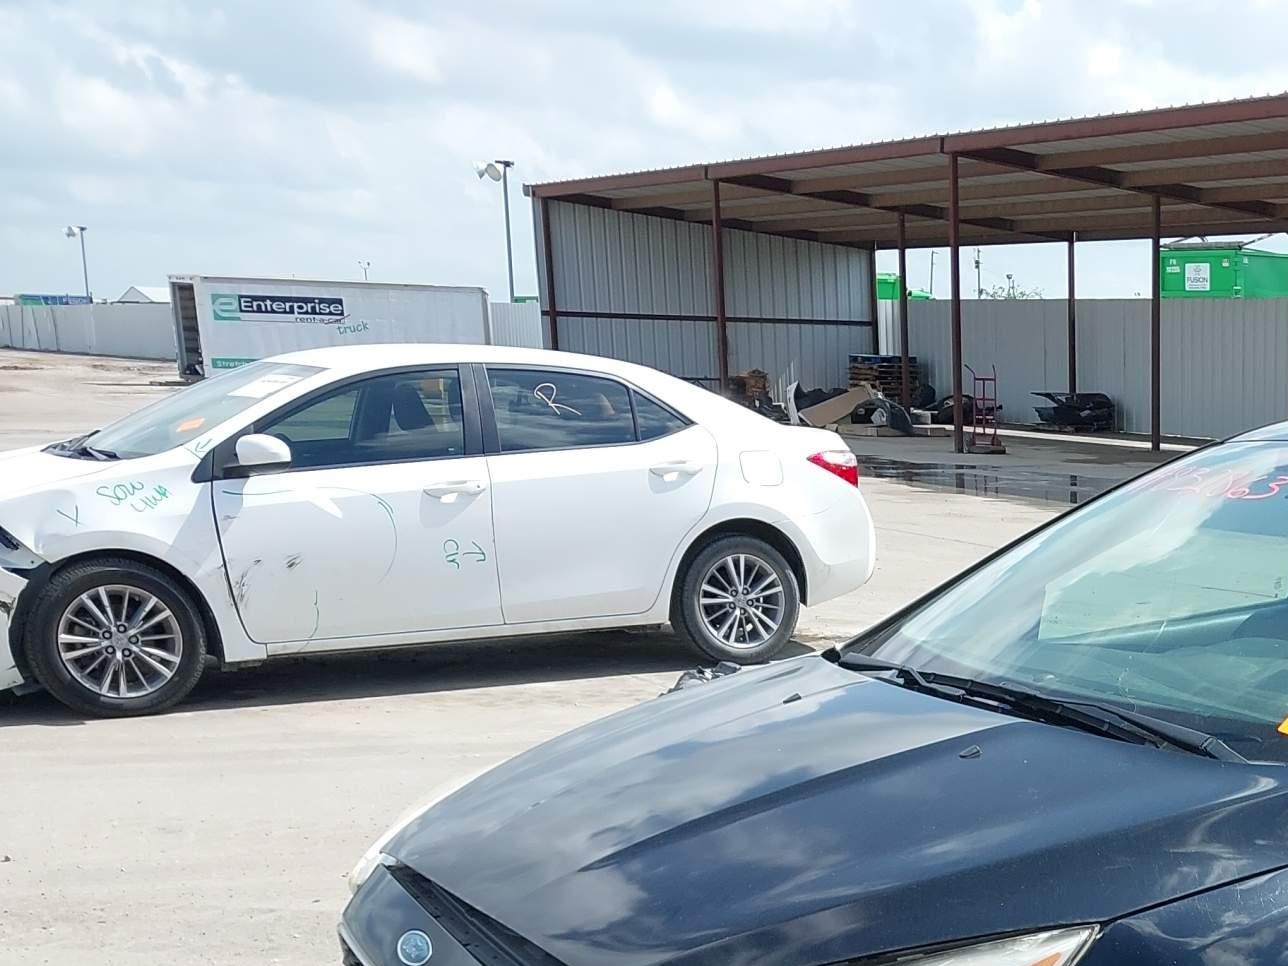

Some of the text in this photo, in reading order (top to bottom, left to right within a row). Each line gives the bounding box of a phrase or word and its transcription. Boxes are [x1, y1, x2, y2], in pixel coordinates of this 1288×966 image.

[240, 297, 343, 316] Enterprise
[337, 320, 368, 334] truck
[534, 383, 582, 415] R
